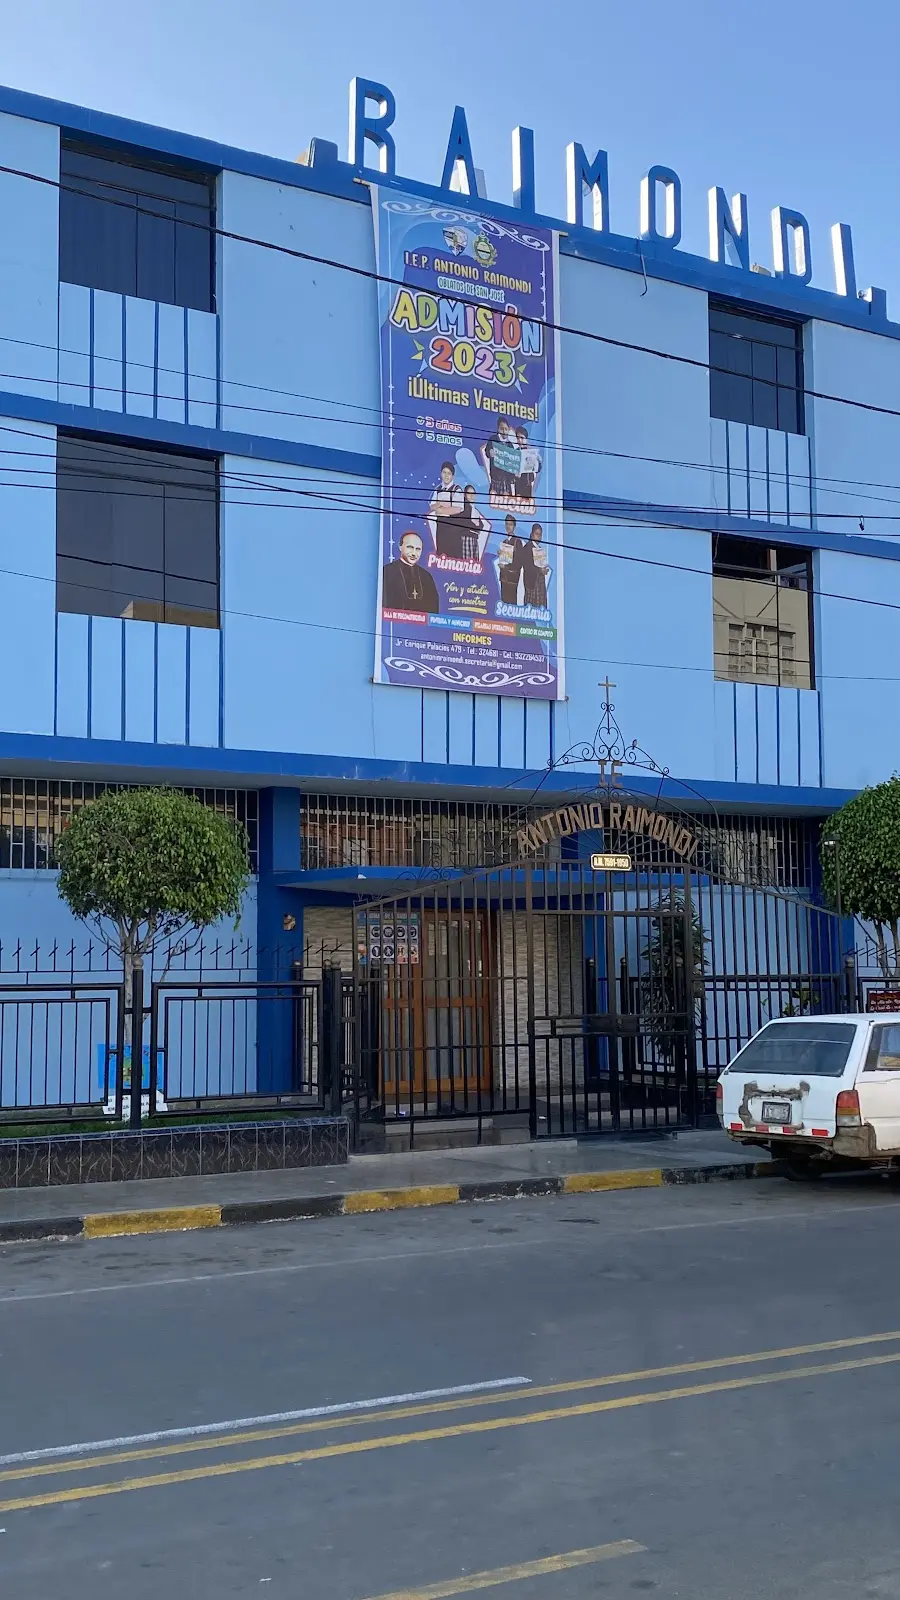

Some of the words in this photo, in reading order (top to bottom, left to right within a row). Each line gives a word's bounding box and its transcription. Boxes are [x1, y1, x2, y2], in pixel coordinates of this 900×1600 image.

[349, 76, 857, 300] RAIMONDI
[405, 252, 429, 270] I.E.P.
[434, 258, 479, 281] ANTONIO
[484, 271, 532, 294] RAIMONDI
[438, 276, 464, 293] OBLATOS
[465, 283, 474, 295] DE
[475, 285, 489, 299] SAN
[390, 289, 543, 356] ADMISIÓN
[430, 337, 515, 385] 2023
[408, 374, 470, 406] ¡Últimas
[474, 388, 539, 422] Vacantes!
[425, 416, 435, 428] 3
[425, 430, 435, 442] 5
[427, 553, 483, 575] Primaria
[449, 596, 461, 604] con
[460, 586, 466, 597] y
[495, 601, 552, 622] Secundaria
[404, 639, 426, 650] Enrique
[427, 642, 450, 652] Palacios
[450, 645, 462, 653] 479
[453, 632, 492, 646] INFORMES
[516, 803, 603, 858] ANTONIO
[609, 803, 700, 862] RAIMONDI
